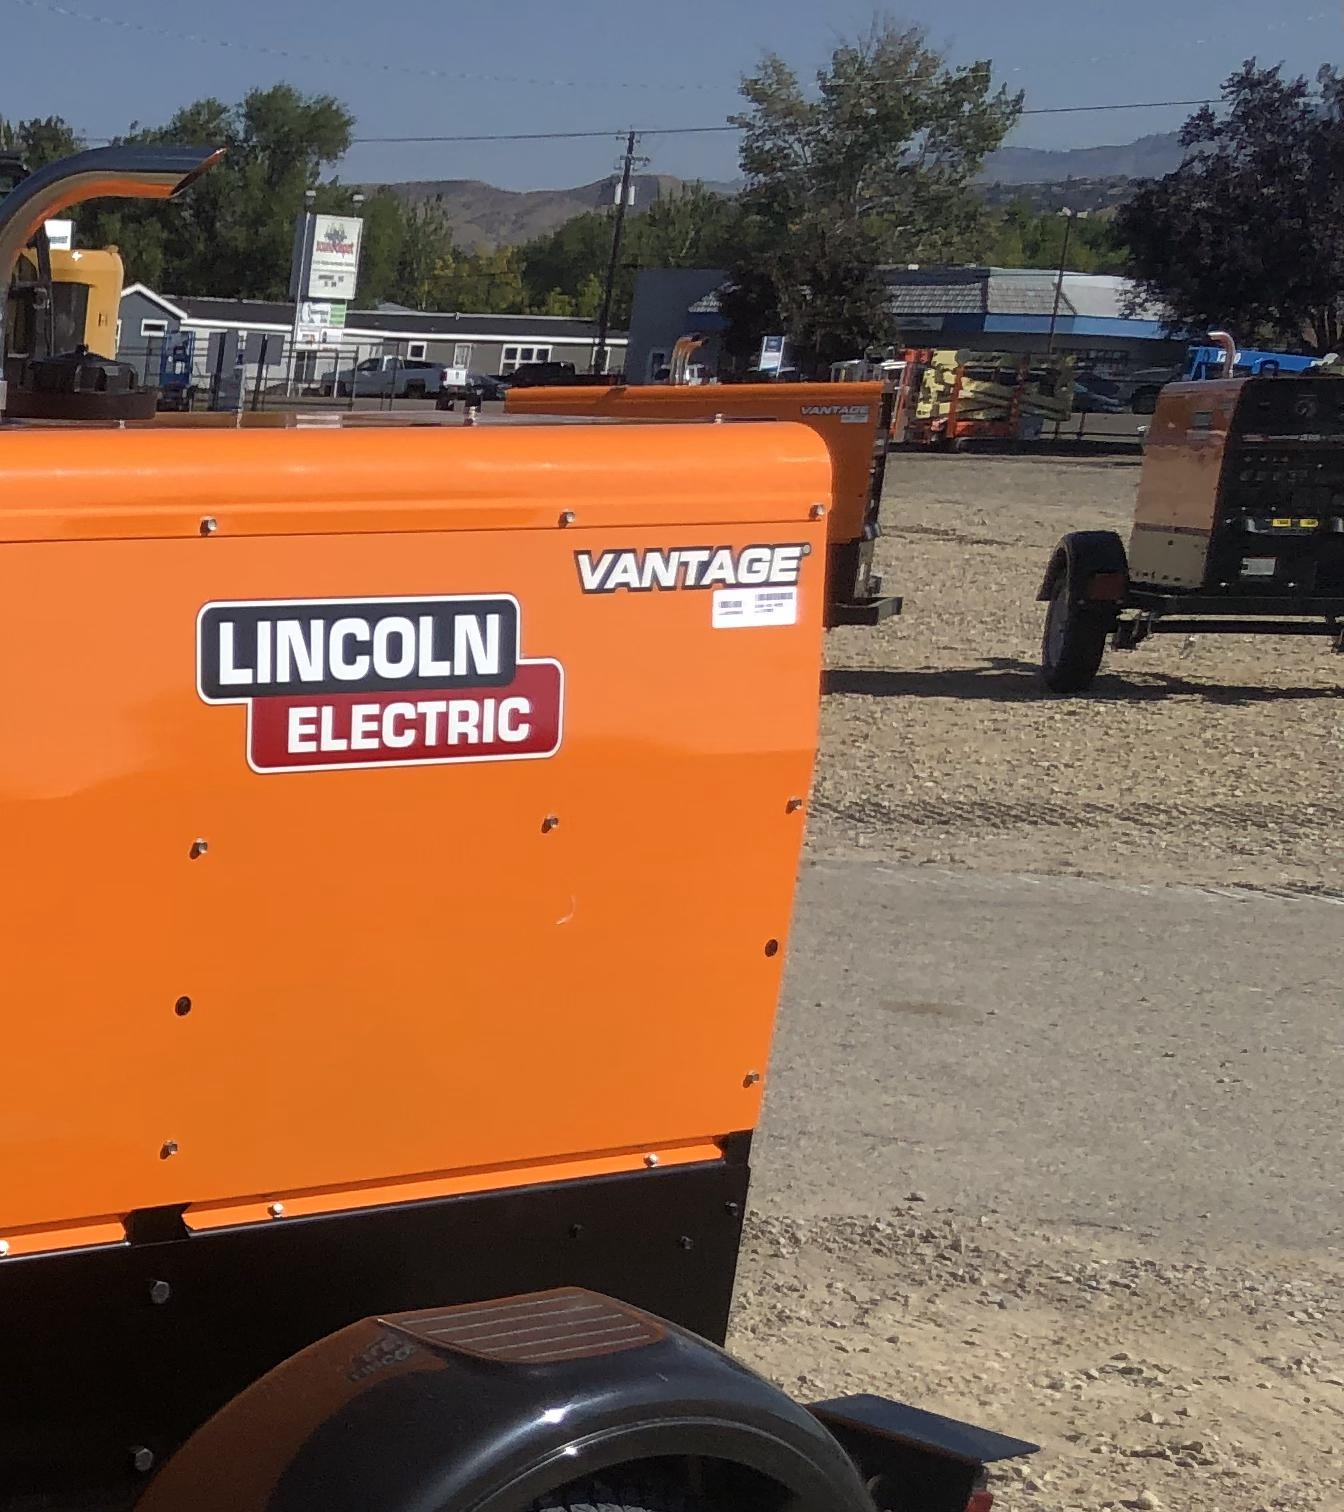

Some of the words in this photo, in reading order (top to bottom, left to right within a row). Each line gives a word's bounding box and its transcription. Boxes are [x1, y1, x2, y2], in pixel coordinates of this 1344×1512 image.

[800, 405, 869, 415] VANTAGE
[576, 545, 803, 590] VANTAGE
[218, 613, 500, 686] LINCOLN
[287, 697, 530, 754] ELECTRIC
